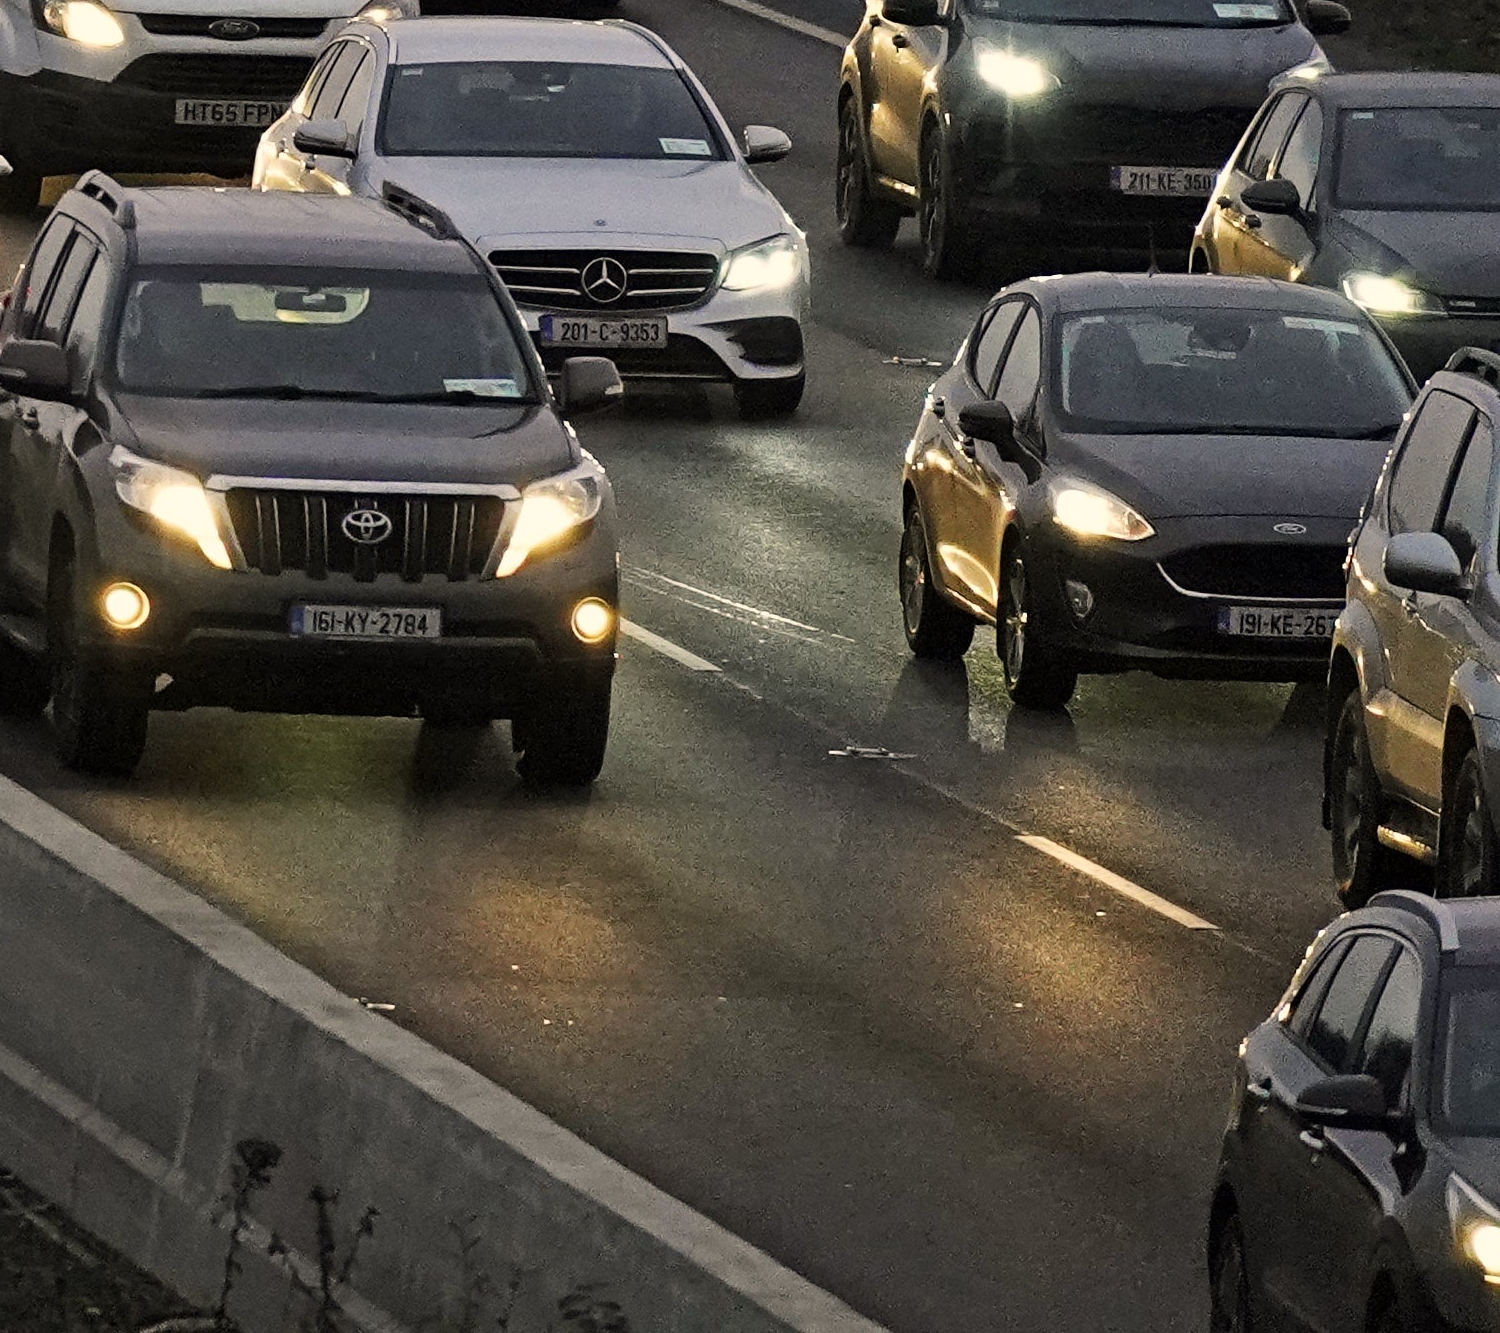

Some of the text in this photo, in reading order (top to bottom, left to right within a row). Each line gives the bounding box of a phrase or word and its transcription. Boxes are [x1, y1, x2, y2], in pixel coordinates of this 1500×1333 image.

[183, 101, 237, 122] HT65
[561, 322, 659, 342] 201-C-9353
[312, 610, 428, 635] 161-KY-2784
